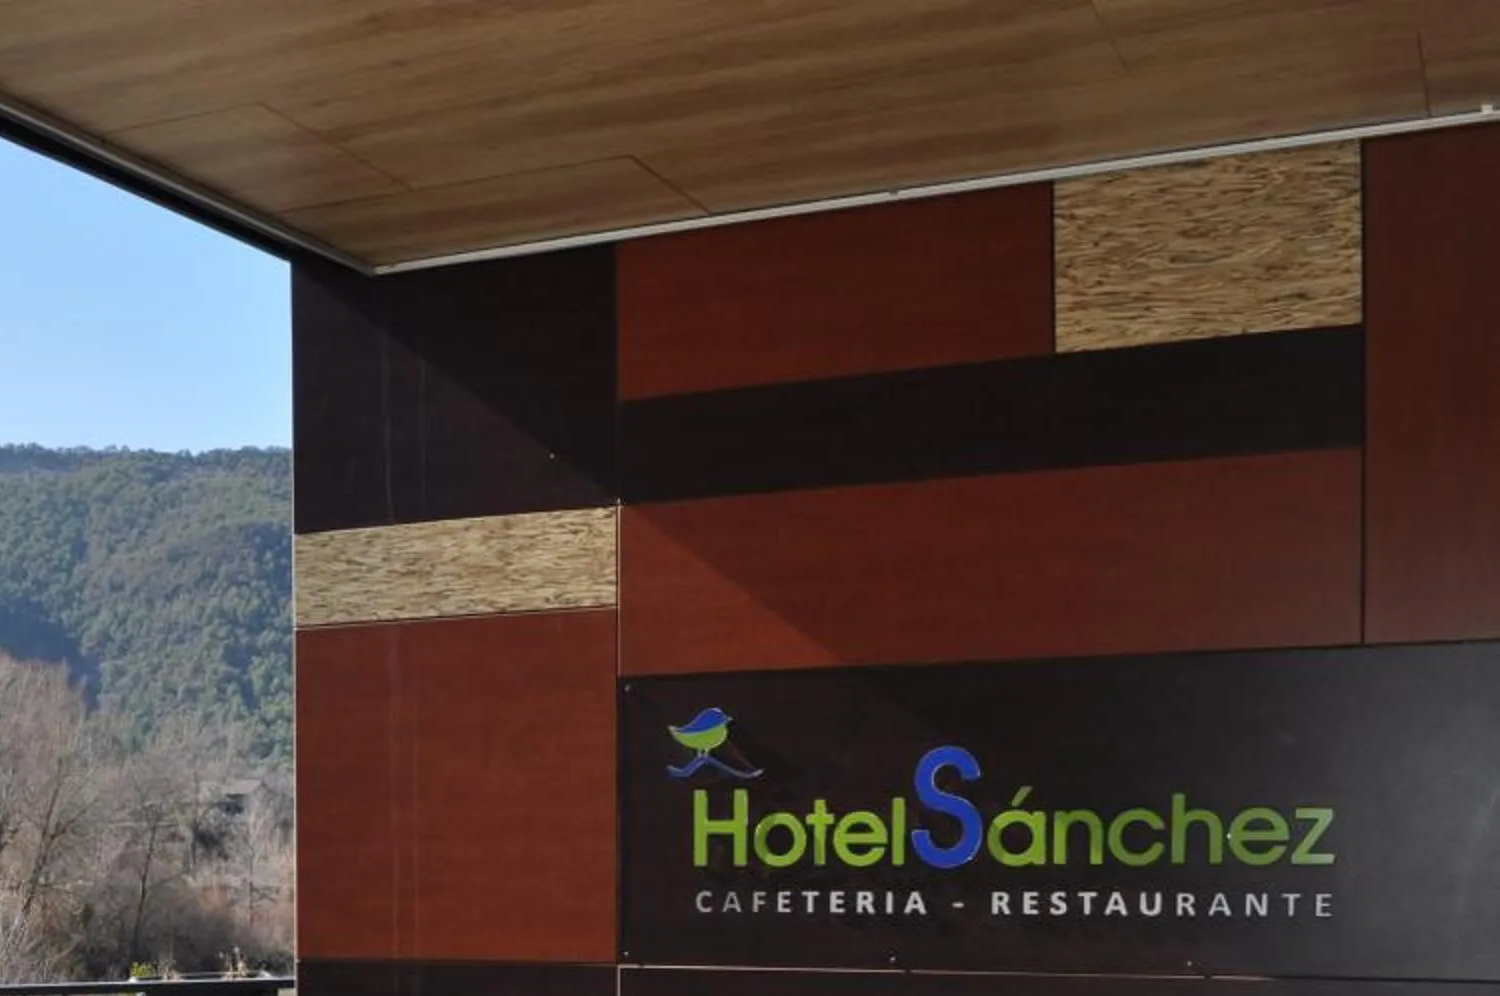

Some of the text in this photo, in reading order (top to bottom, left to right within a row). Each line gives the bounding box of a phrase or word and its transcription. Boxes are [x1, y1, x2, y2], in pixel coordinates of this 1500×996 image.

[692, 746, 1336, 869] Hotel Sánchez
[695, 890, 927, 915] CAFETERIA
[991, 891, 1333, 918] RESTAURANTE
